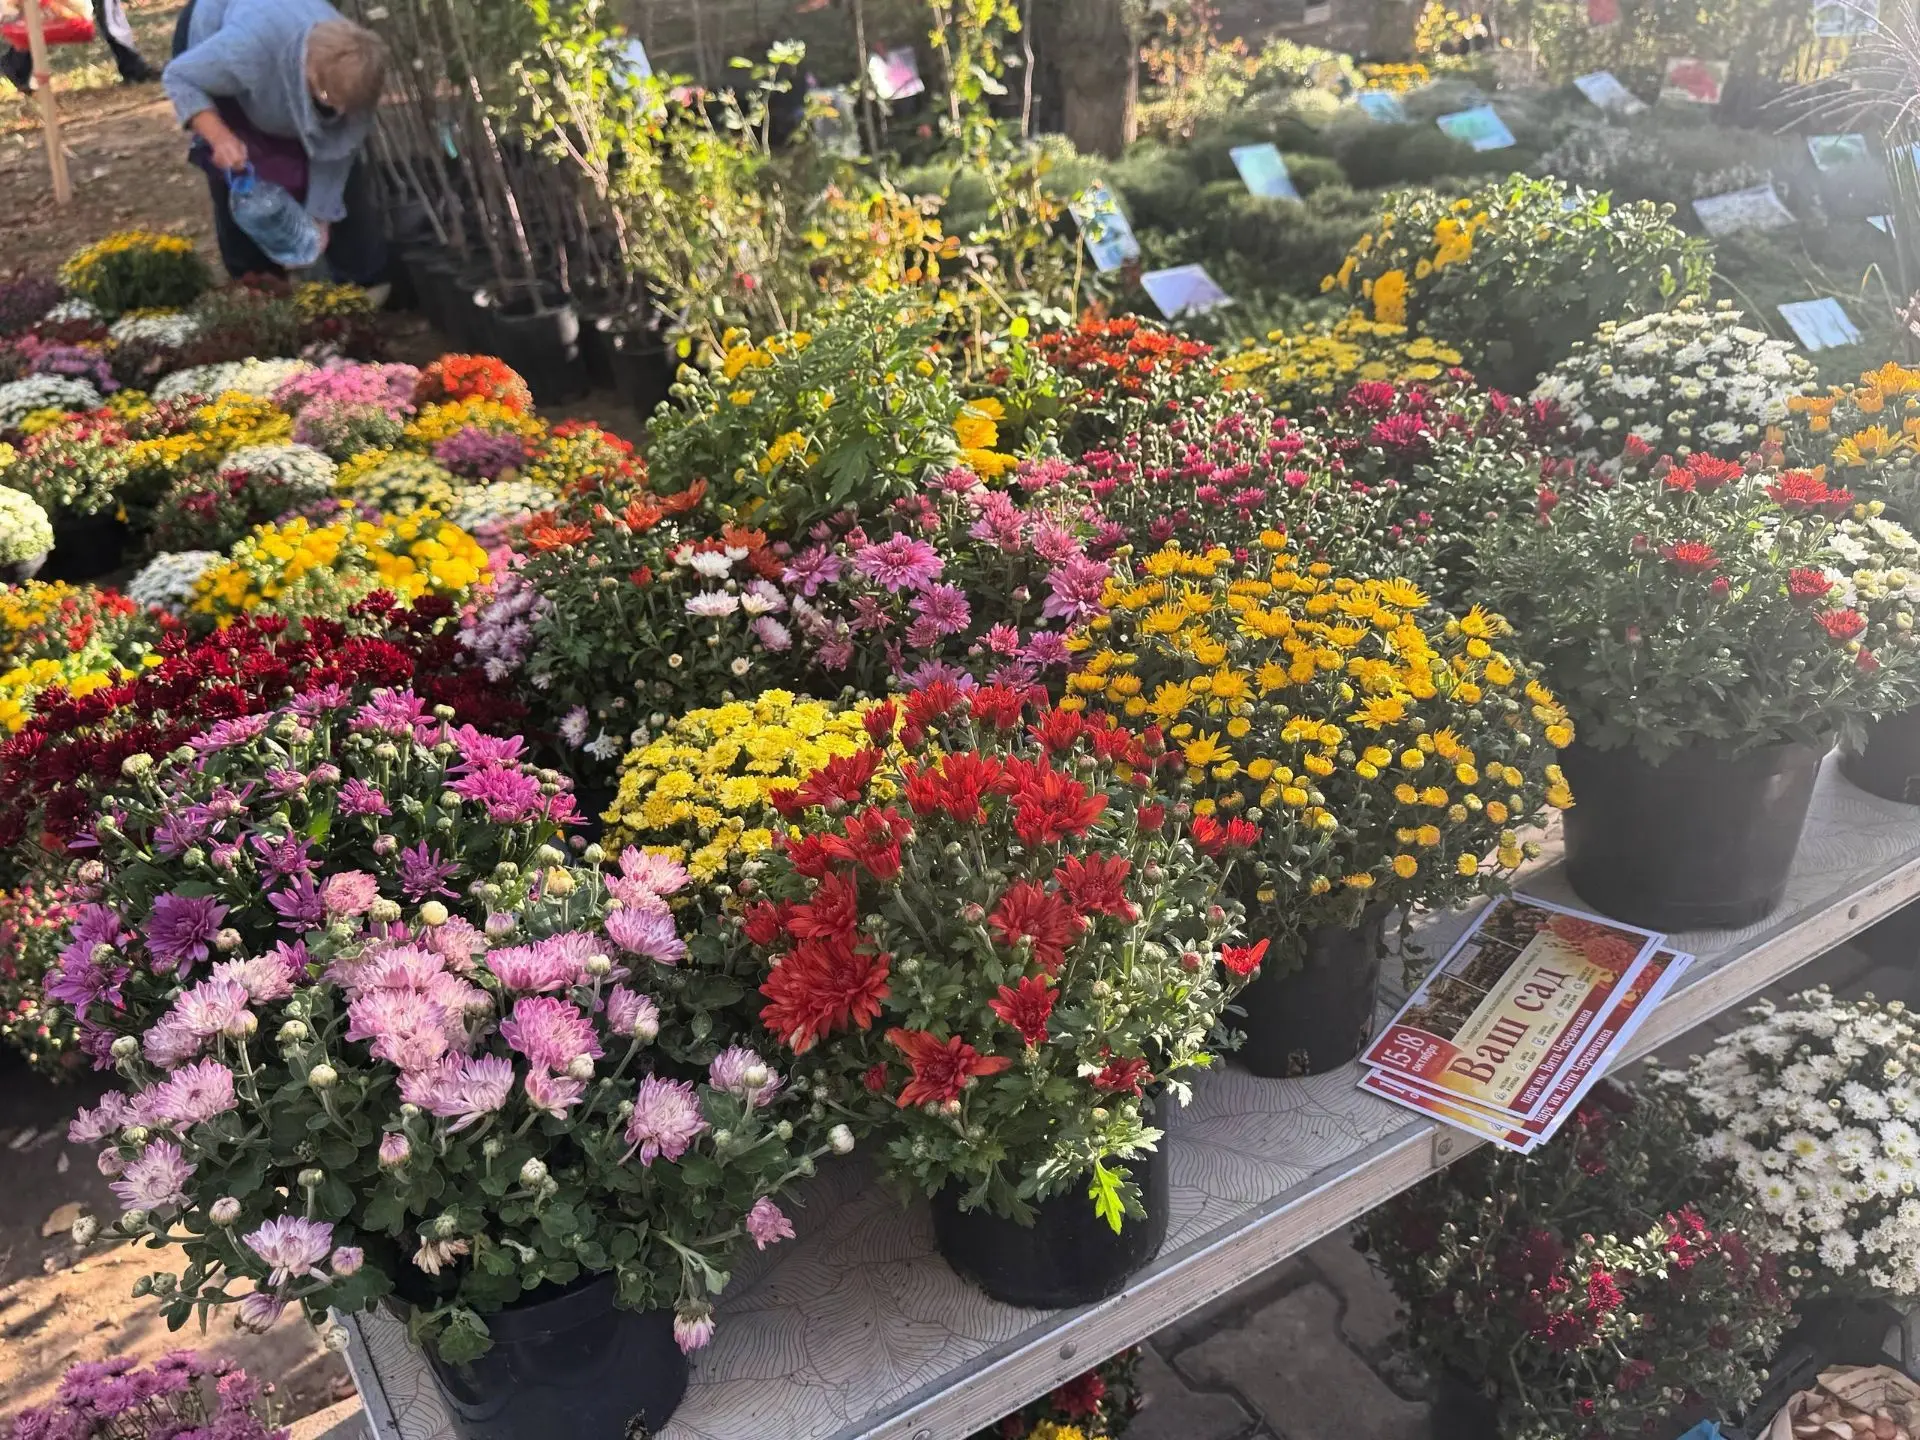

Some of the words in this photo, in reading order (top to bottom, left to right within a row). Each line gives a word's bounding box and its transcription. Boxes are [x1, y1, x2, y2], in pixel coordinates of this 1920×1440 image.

[1447, 1016, 1530, 1085] Ваш
[1513, 967, 1574, 1012] сад
[1552, 1009, 1593, 1051] Черевичкина
[1380, 1032, 1425, 1068] 15-18
[1411, 1043, 1440, 1072] октября
[1571, 1029, 1614, 1071] Черевичкина
[1539, 1052, 1563, 1073] Вити
[1532, 1073, 1550, 1086] им.
[1555, 1072, 1580, 1092] Вити
[1520, 1085, 1541, 1104] парк
[1547, 1093, 1566, 1106] им.
[1534, 1104, 1556, 1124] парк
